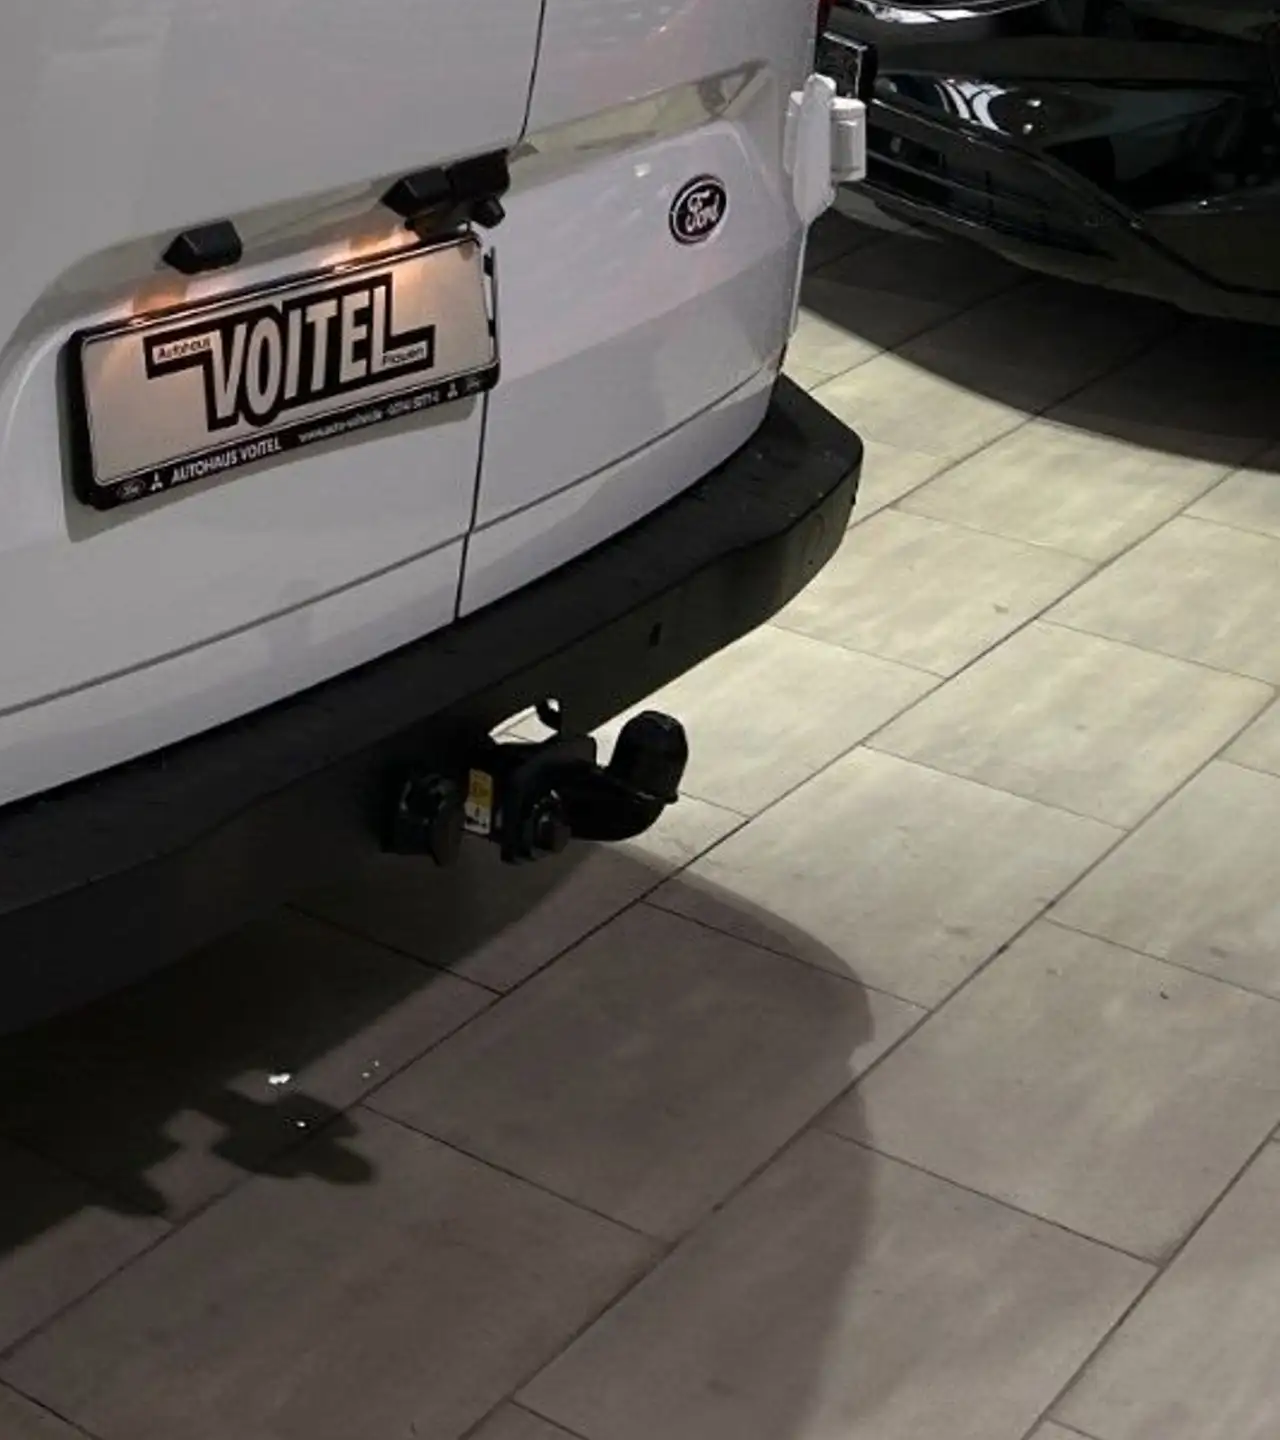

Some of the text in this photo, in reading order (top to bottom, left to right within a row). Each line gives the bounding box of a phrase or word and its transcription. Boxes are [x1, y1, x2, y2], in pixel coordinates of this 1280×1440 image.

[210, 284, 386, 418] VOITEL
[170, 450, 237, 485] AUTOHAUS
[240, 436, 282, 461] VOITEL
